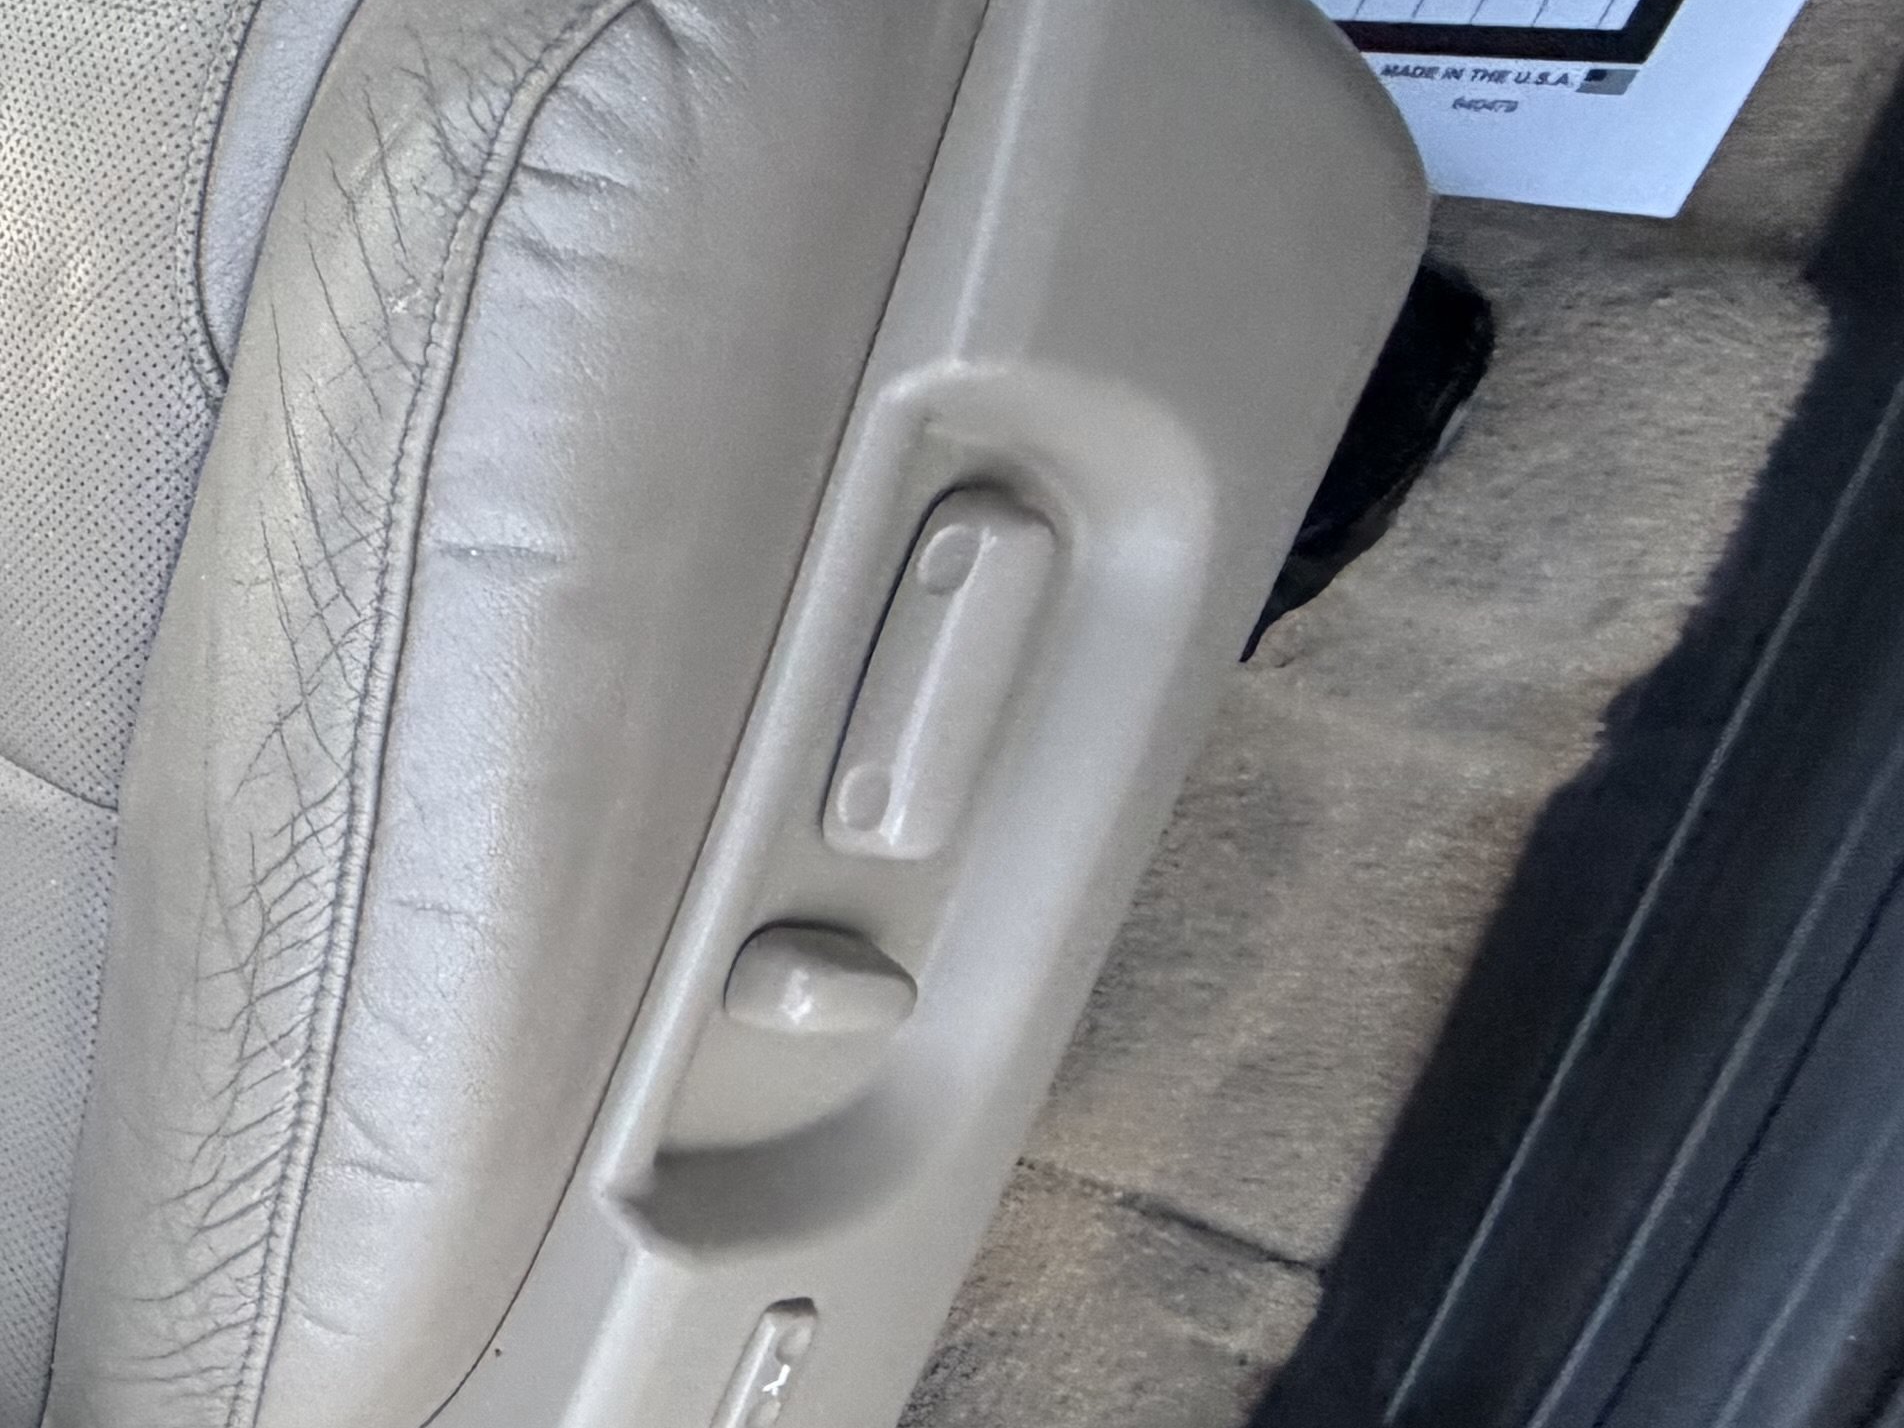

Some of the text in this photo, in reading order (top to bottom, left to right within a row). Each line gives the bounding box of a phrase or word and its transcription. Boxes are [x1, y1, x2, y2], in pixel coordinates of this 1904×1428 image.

[1380, 64, 1436, 81] MADE
[1442, 66, 1465, 82] IN
[1470, 68, 1510, 84] THE
